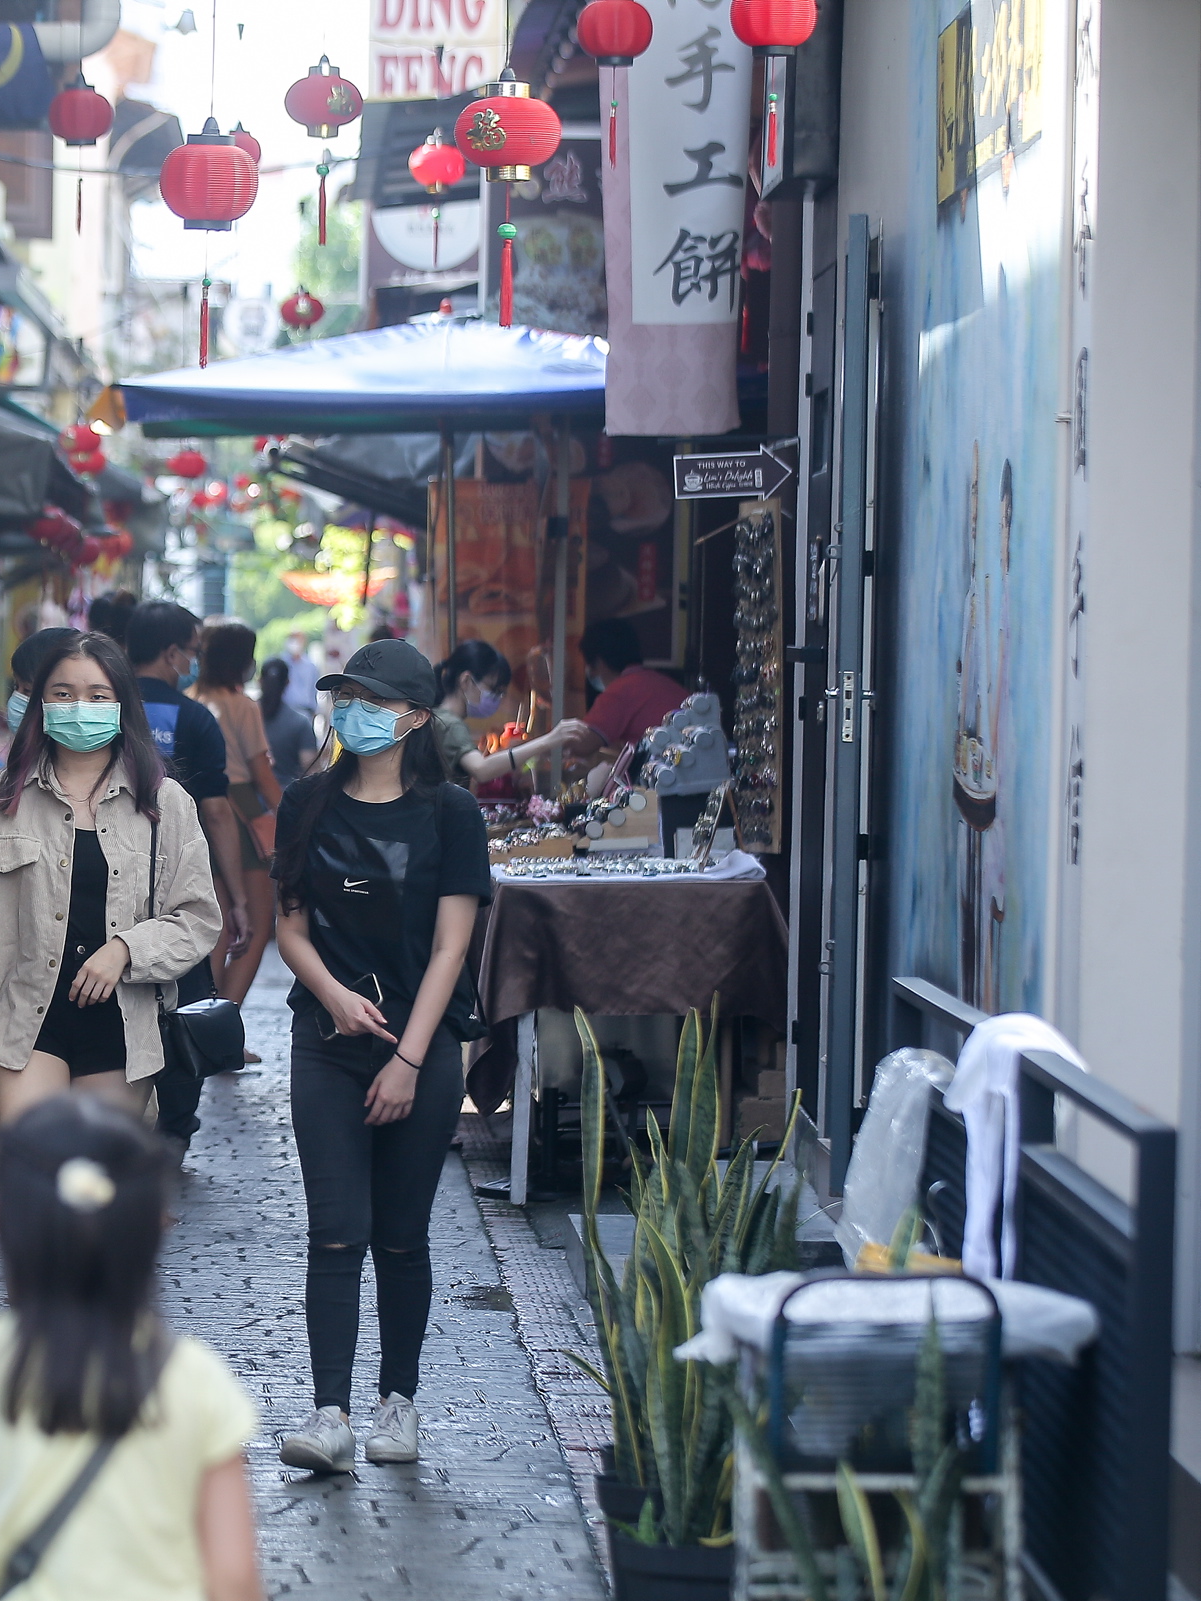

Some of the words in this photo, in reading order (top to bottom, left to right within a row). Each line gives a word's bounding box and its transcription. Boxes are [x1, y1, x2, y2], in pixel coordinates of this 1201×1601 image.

[465, 108, 507, 151] 福
[653, 0, 743, 313] 手工餅
[697, 462, 715, 470] THIS
[717, 461, 733, 469] WAY
[735, 460, 746, 468] TO
